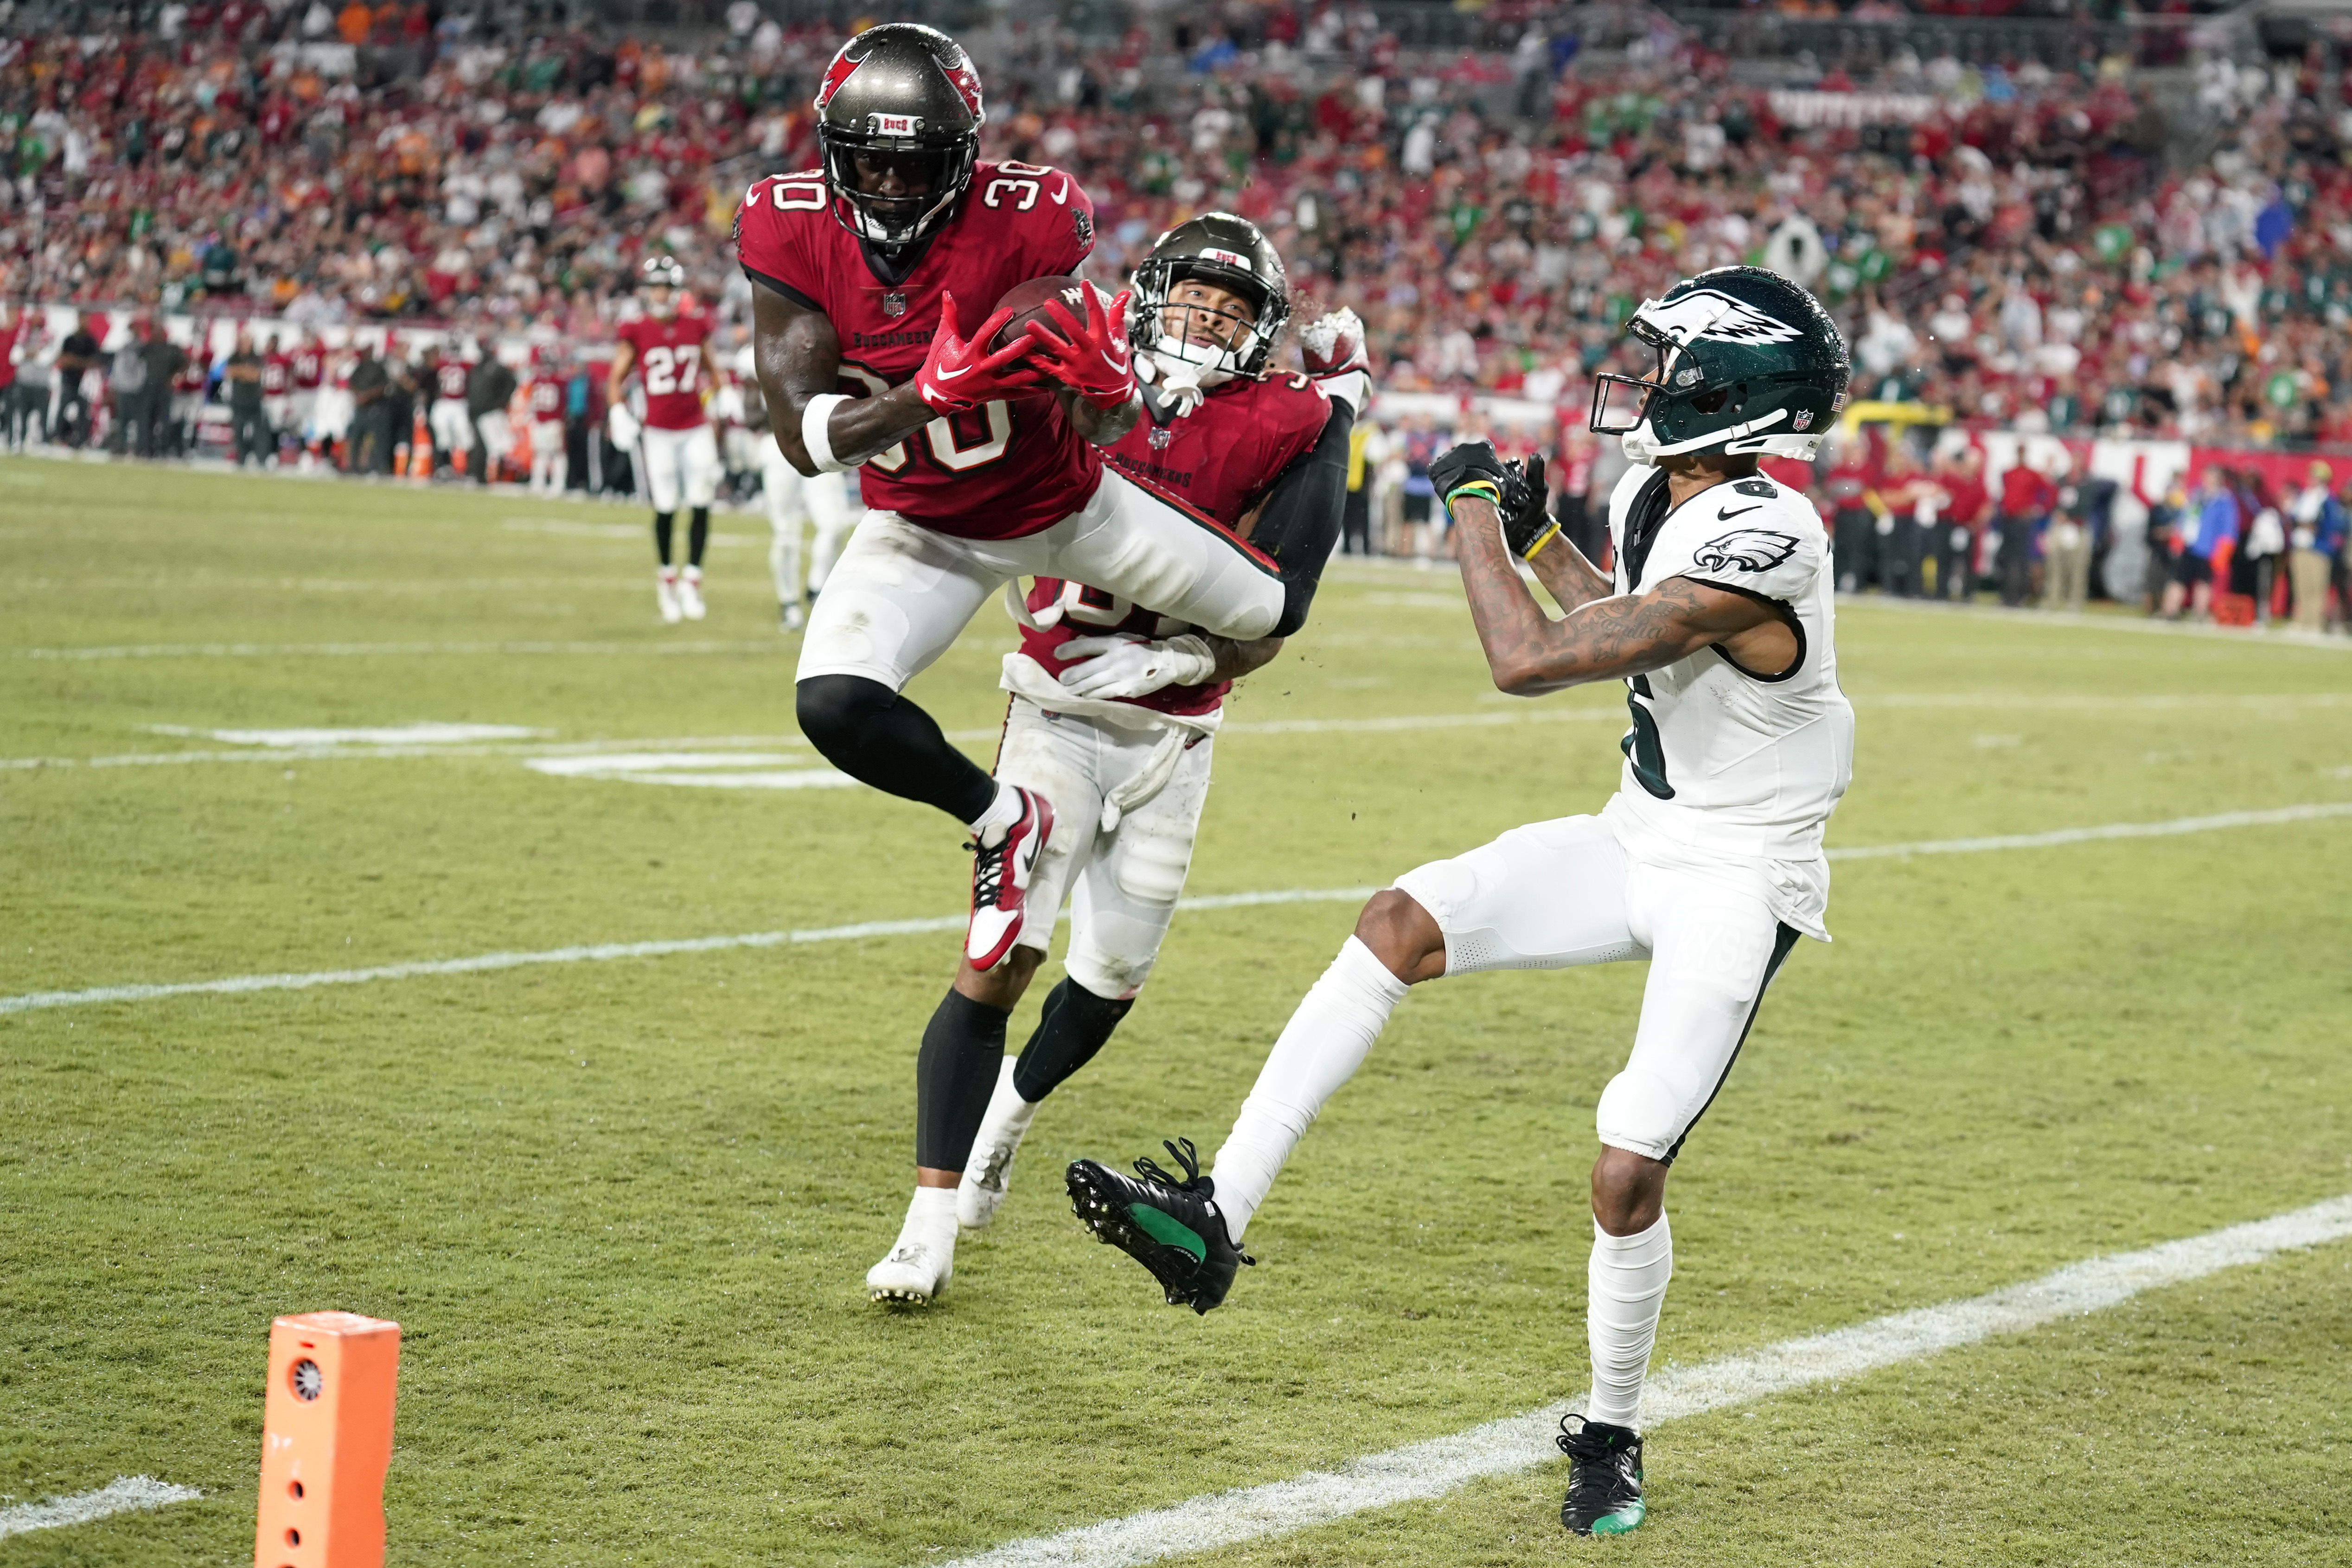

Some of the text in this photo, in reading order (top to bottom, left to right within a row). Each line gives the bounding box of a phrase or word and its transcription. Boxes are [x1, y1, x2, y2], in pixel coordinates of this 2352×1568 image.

[644, 344, 701, 396] 27
[1795, 419, 1808, 429] NFL
[1115, 452, 1192, 487] BUCCANEERS
